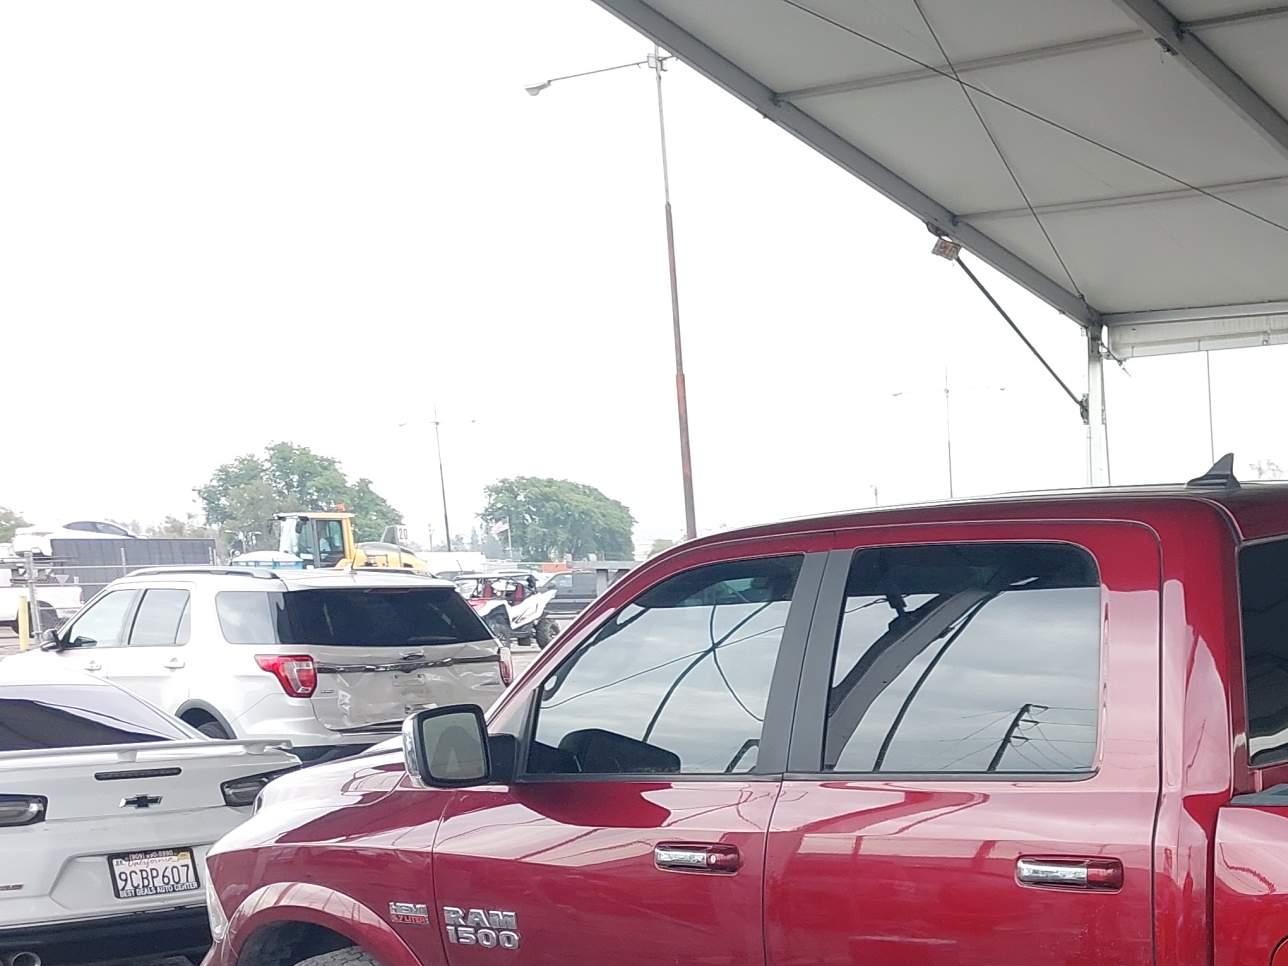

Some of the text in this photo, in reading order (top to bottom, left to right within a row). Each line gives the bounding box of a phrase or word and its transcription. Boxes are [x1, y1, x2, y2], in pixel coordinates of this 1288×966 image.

[119, 864, 190, 891] 9CBP607
[136, 886, 157, 896] DEALS
[157, 884, 174, 893] AUTO
[174, 882, 198, 891] CENTER
[443, 906, 517, 929] RAM
[446, 926, 519, 949] 1500
